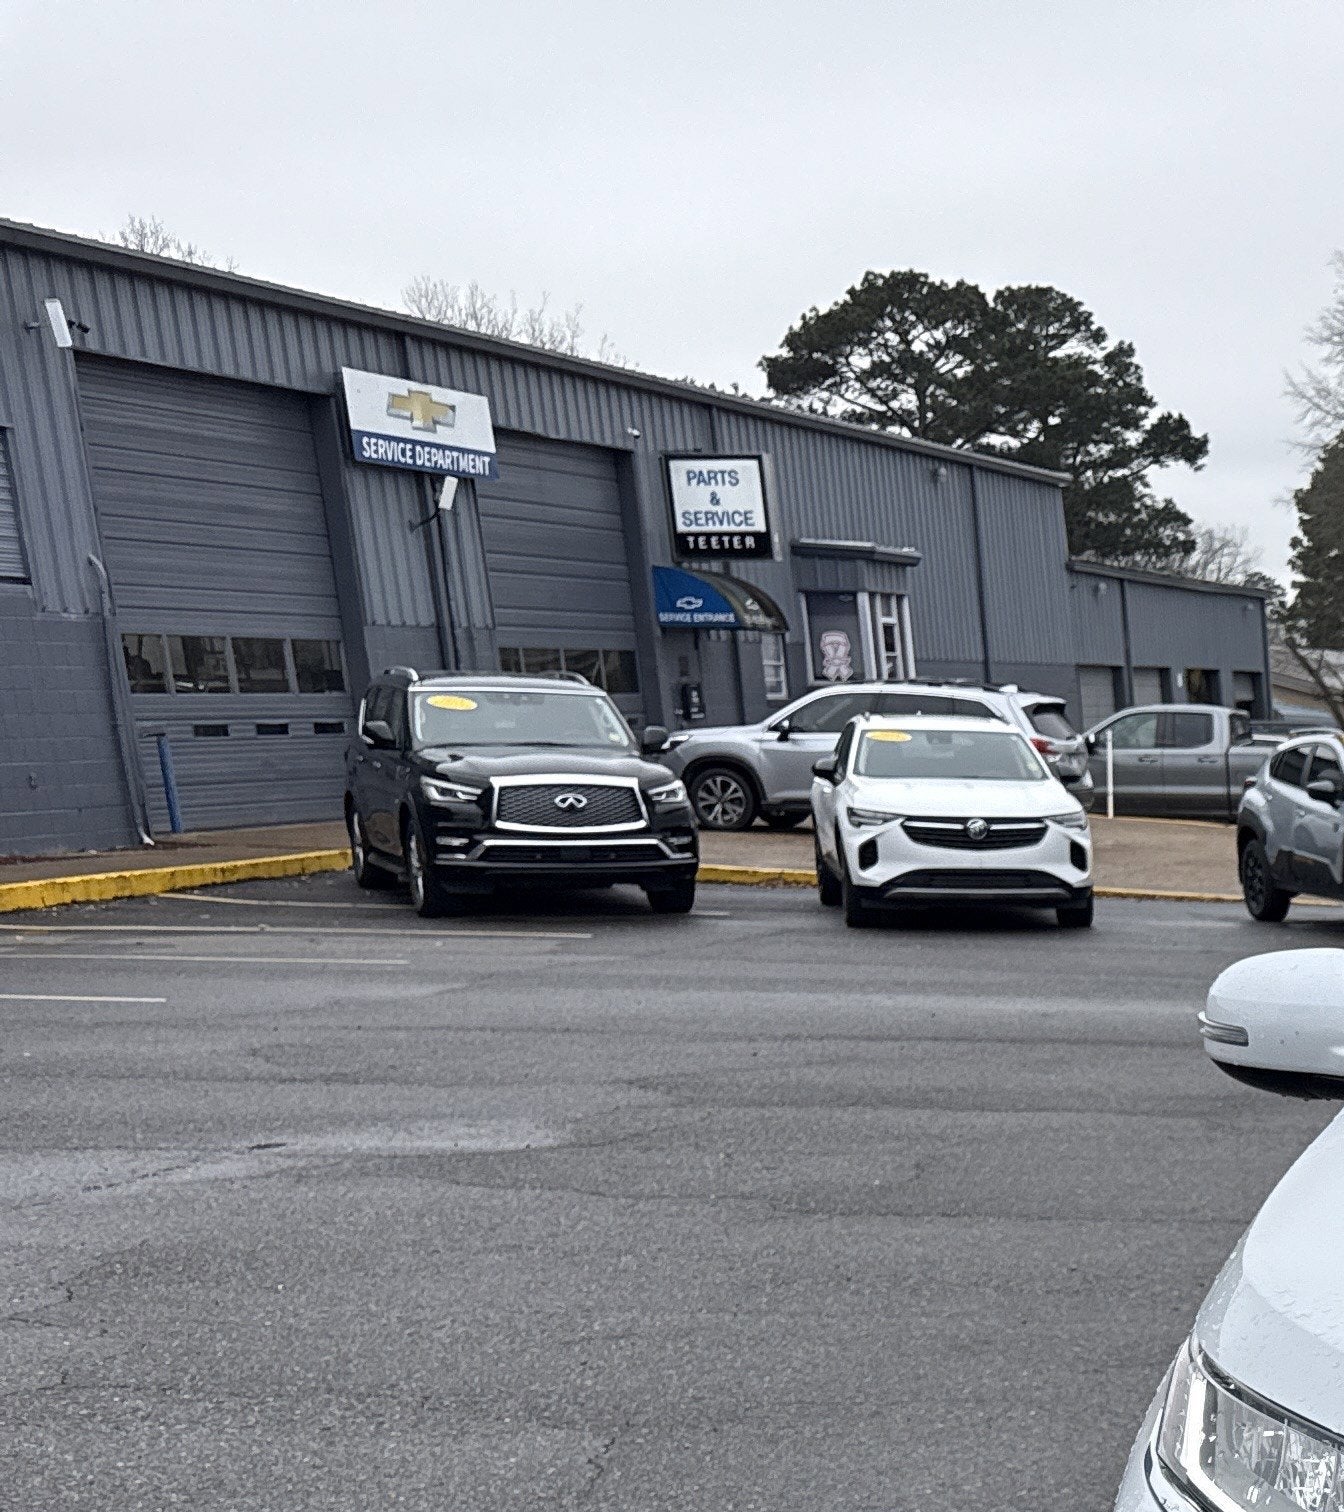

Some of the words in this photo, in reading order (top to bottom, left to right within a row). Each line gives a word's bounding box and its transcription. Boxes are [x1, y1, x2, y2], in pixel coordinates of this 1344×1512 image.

[361, 436, 413, 465] SERVICE
[415, 445, 491, 476] DEPARTMENT
[686, 469, 740, 487] PARTS
[709, 491, 720, 506] &
[681, 510, 756, 528] SERVICE
[687, 535, 756, 550] TEETER
